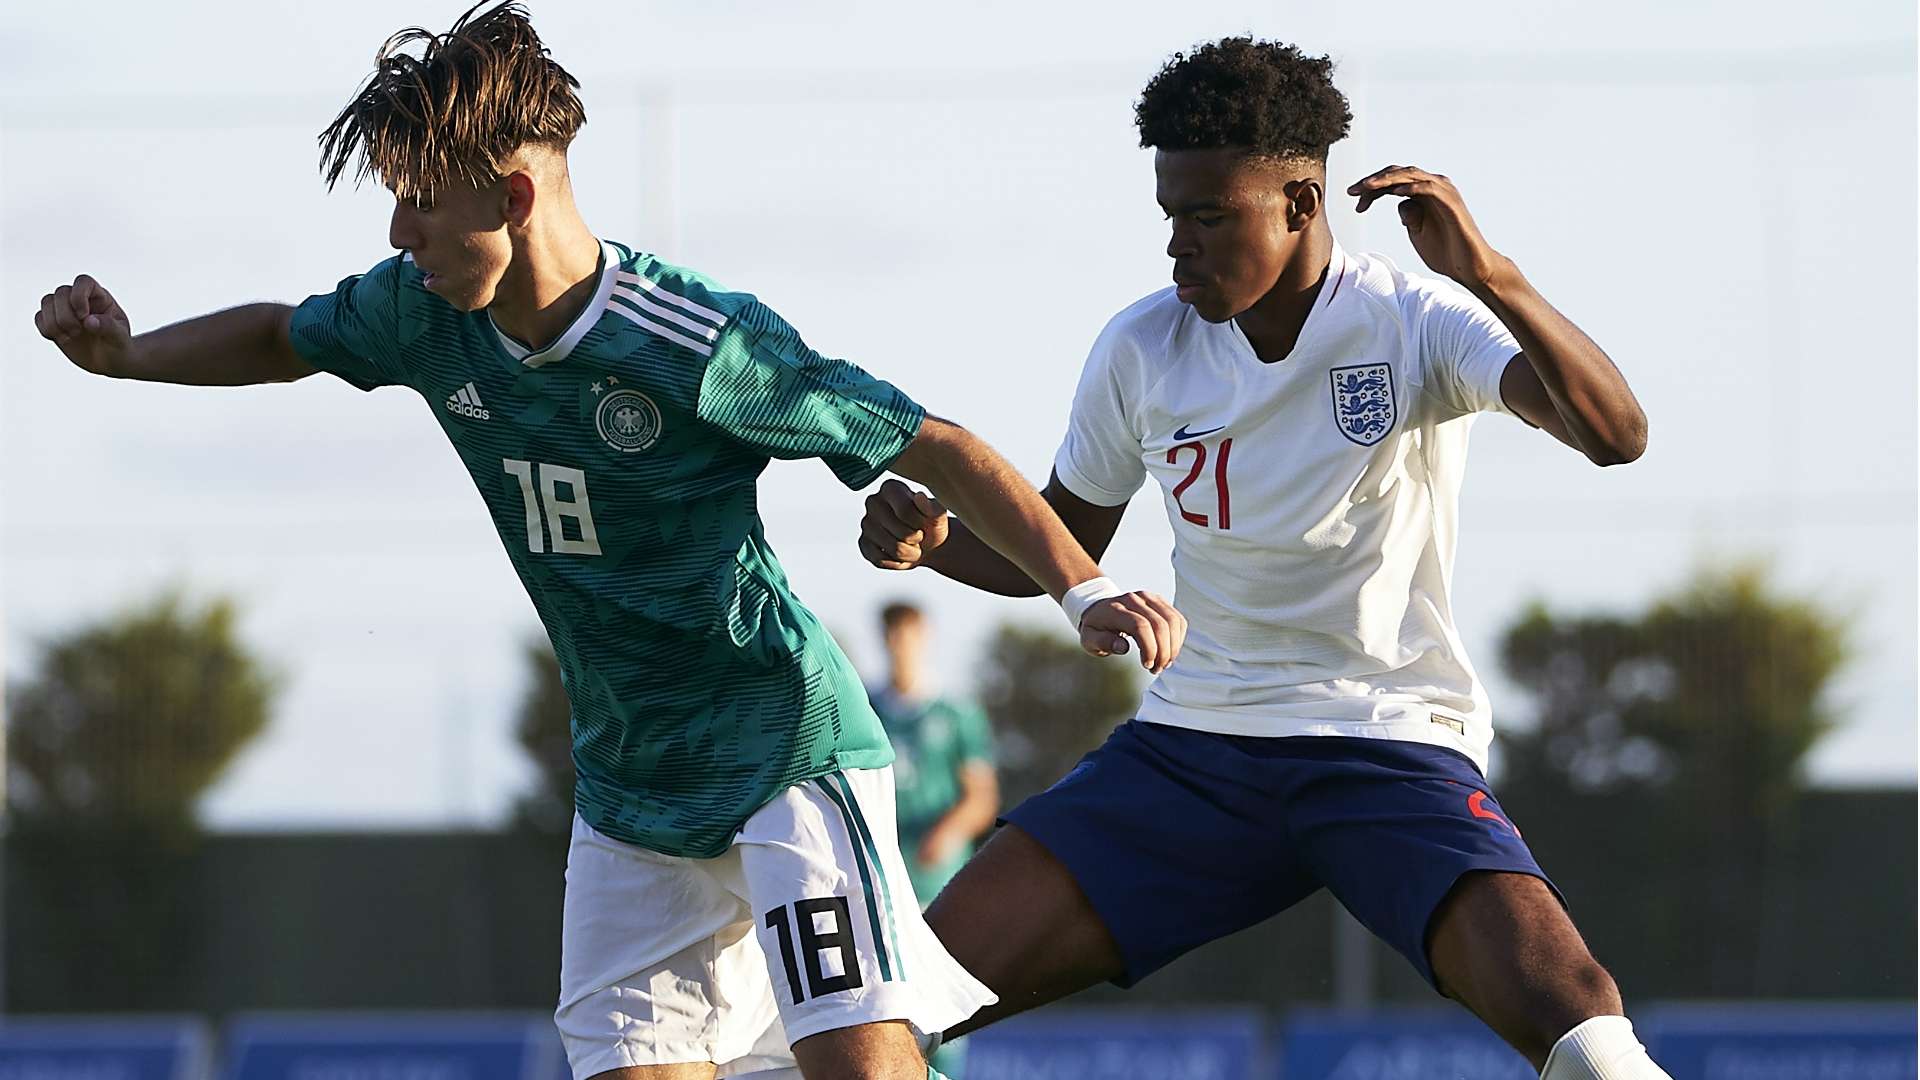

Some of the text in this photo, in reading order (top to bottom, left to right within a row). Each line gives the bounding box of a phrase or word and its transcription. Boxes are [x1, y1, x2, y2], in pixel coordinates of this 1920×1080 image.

[446, 401, 490, 420] adidas
[502, 458, 603, 556] 18
[1166, 438, 1233, 530] 21
[764, 895, 864, 1006] 18
